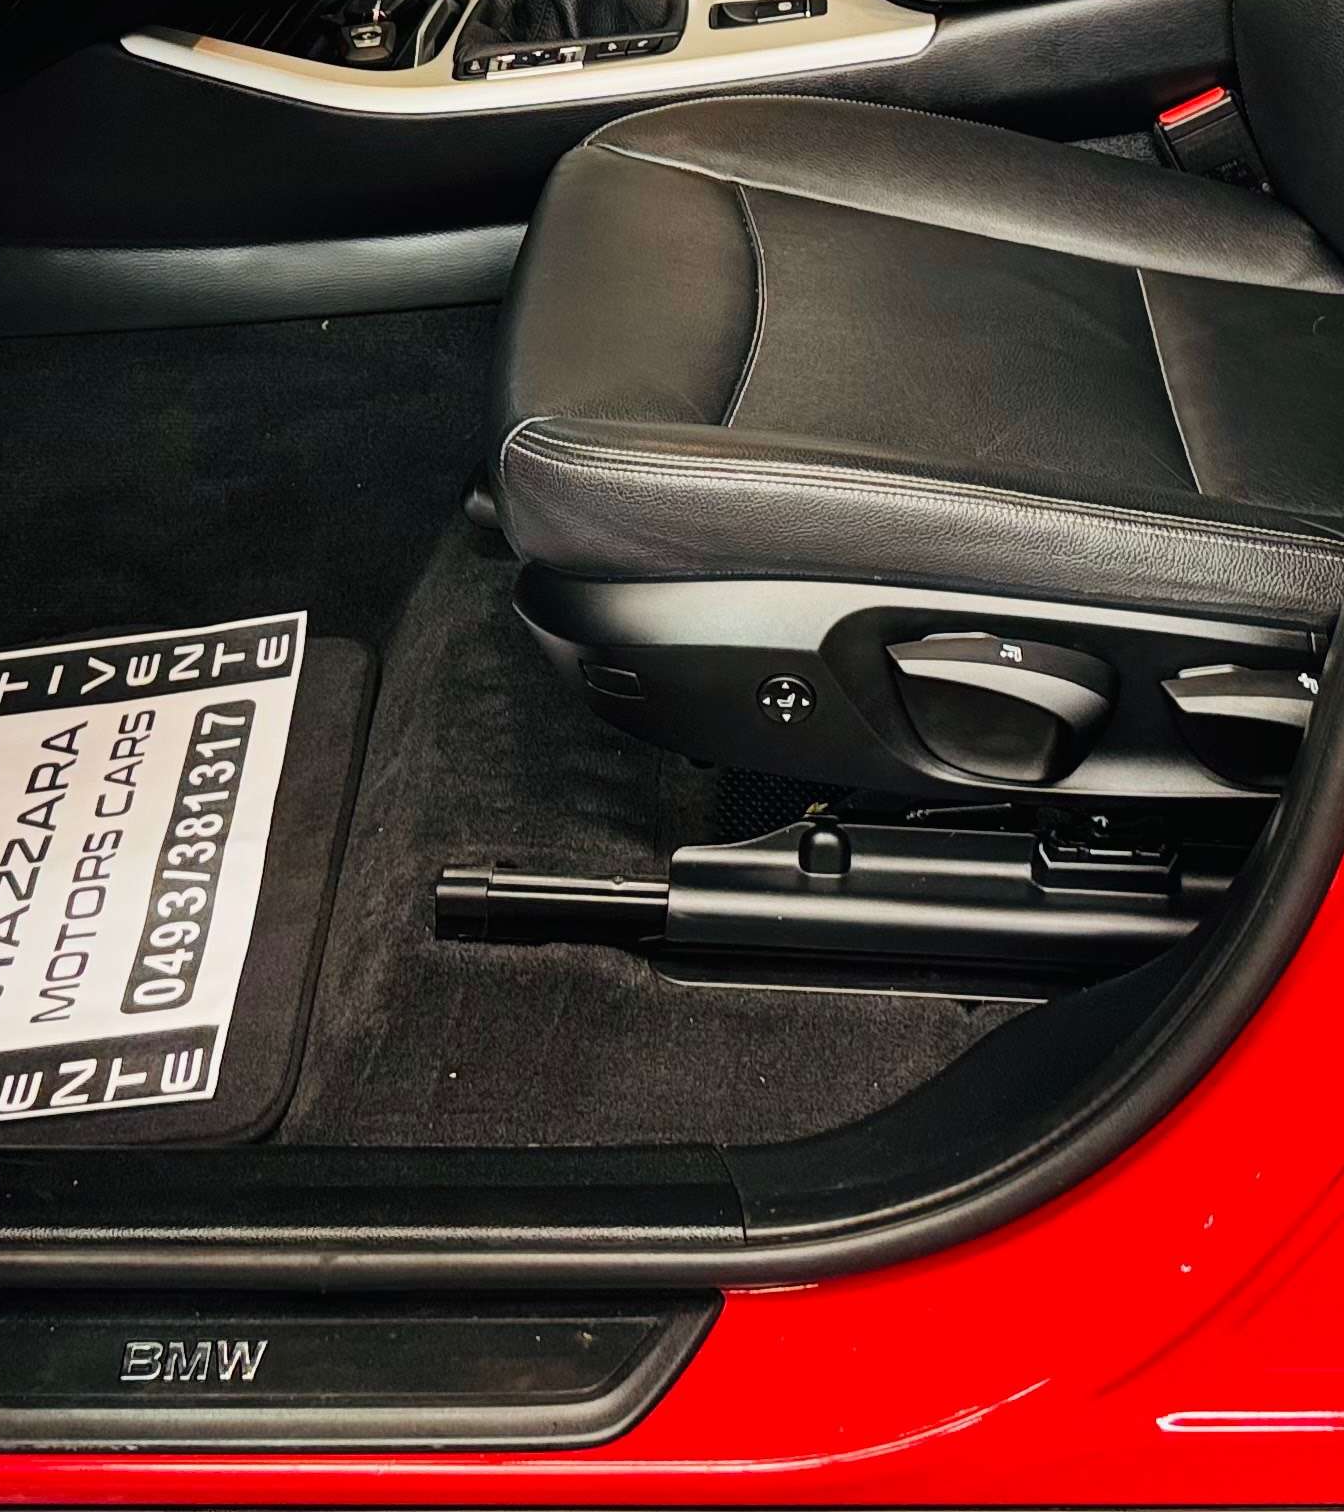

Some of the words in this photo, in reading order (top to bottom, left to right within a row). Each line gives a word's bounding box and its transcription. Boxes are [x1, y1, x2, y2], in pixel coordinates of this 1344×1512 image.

[30, 829, 123, 1024] MOTORS
[94, 708, 156, 818] CARS
[133, 705, 247, 1006] 0493/381317
[120, 1340, 268, 1381] BMW
